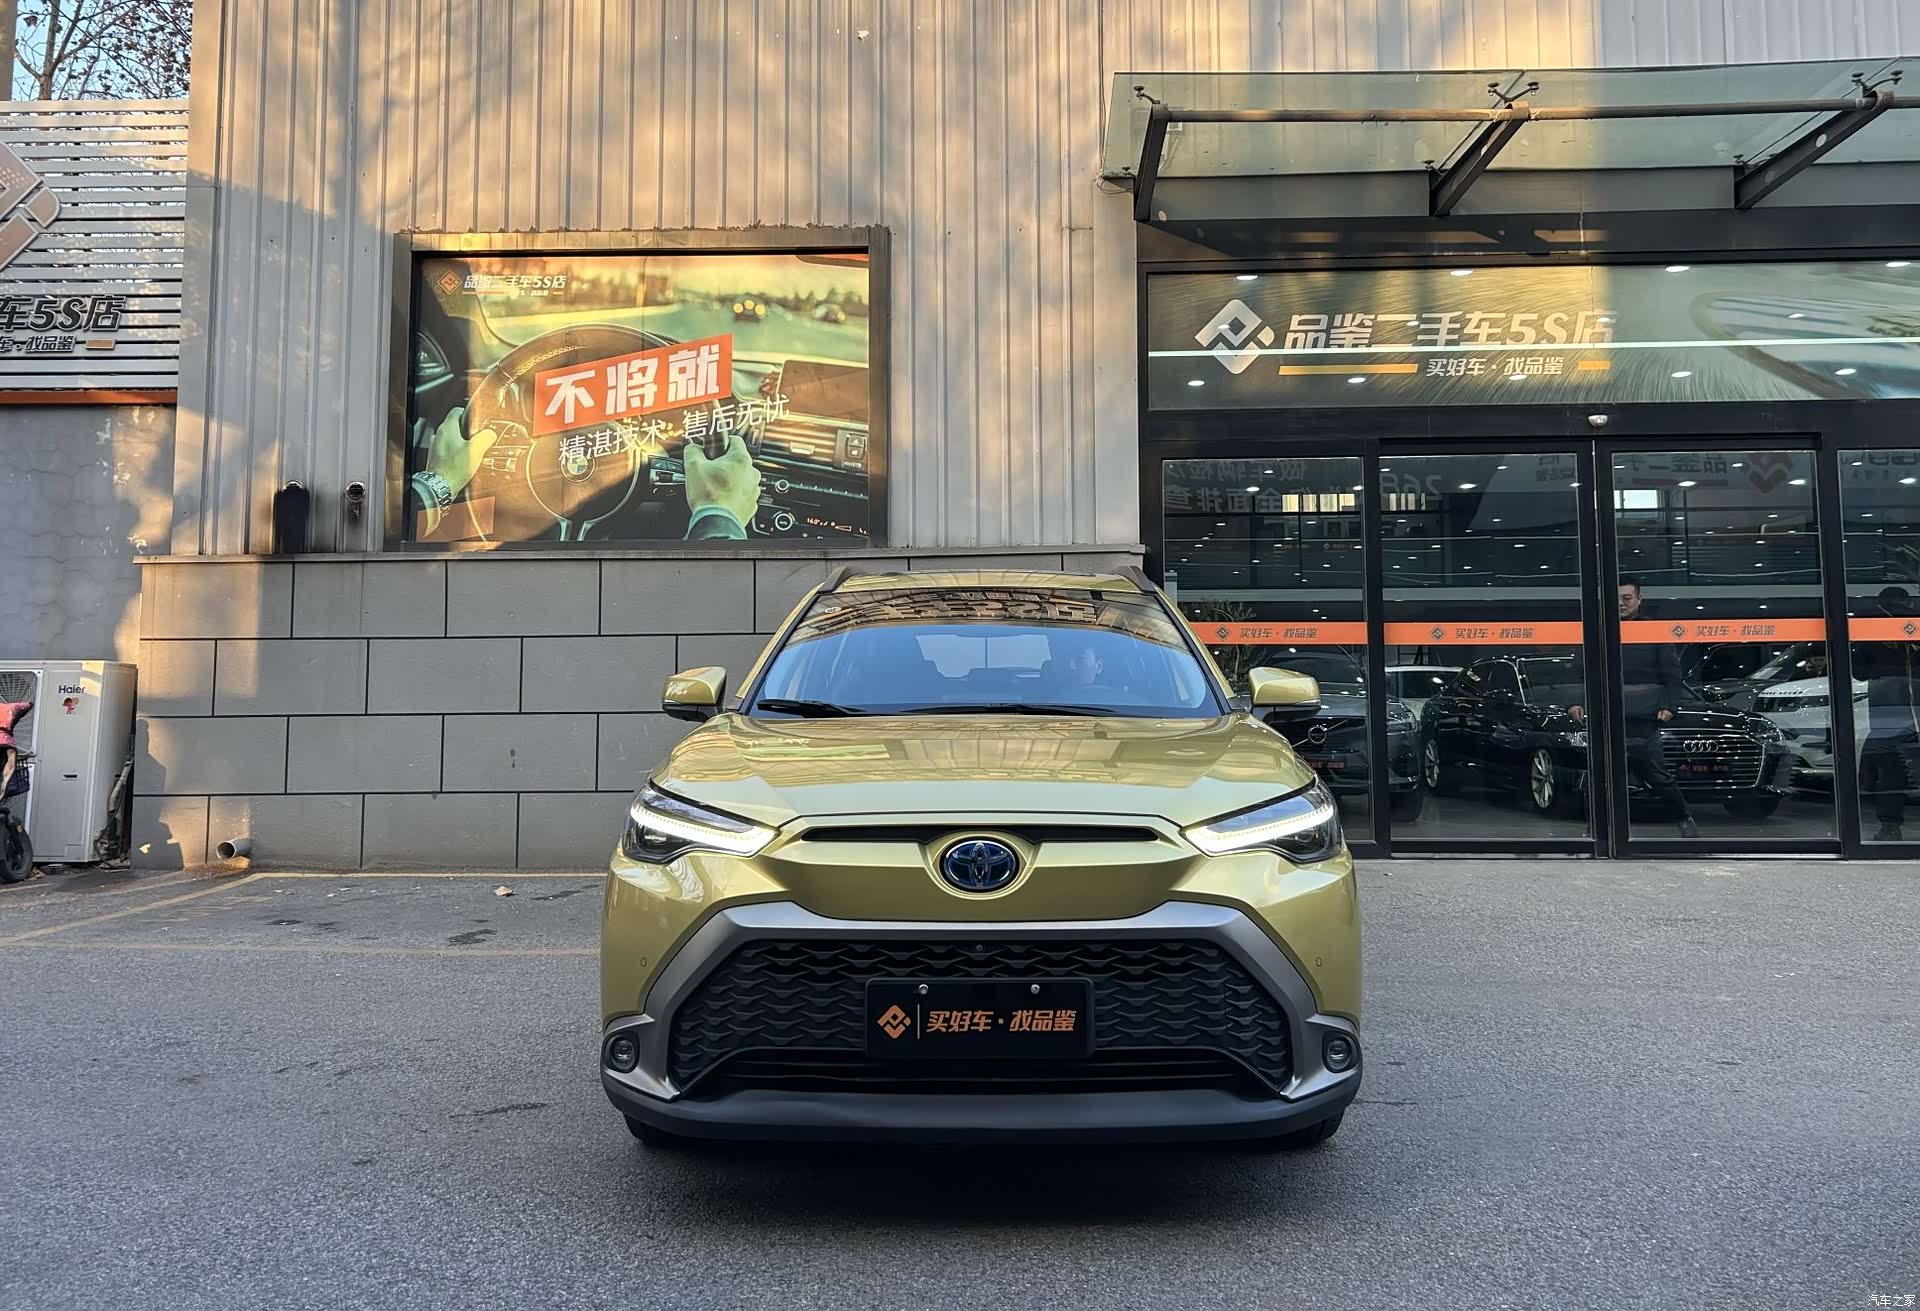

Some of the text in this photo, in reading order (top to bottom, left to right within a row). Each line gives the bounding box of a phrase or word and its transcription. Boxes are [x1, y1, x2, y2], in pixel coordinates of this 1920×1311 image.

[545, 343, 720, 424] 不将就
[58, 685, 86, 694] Haier
